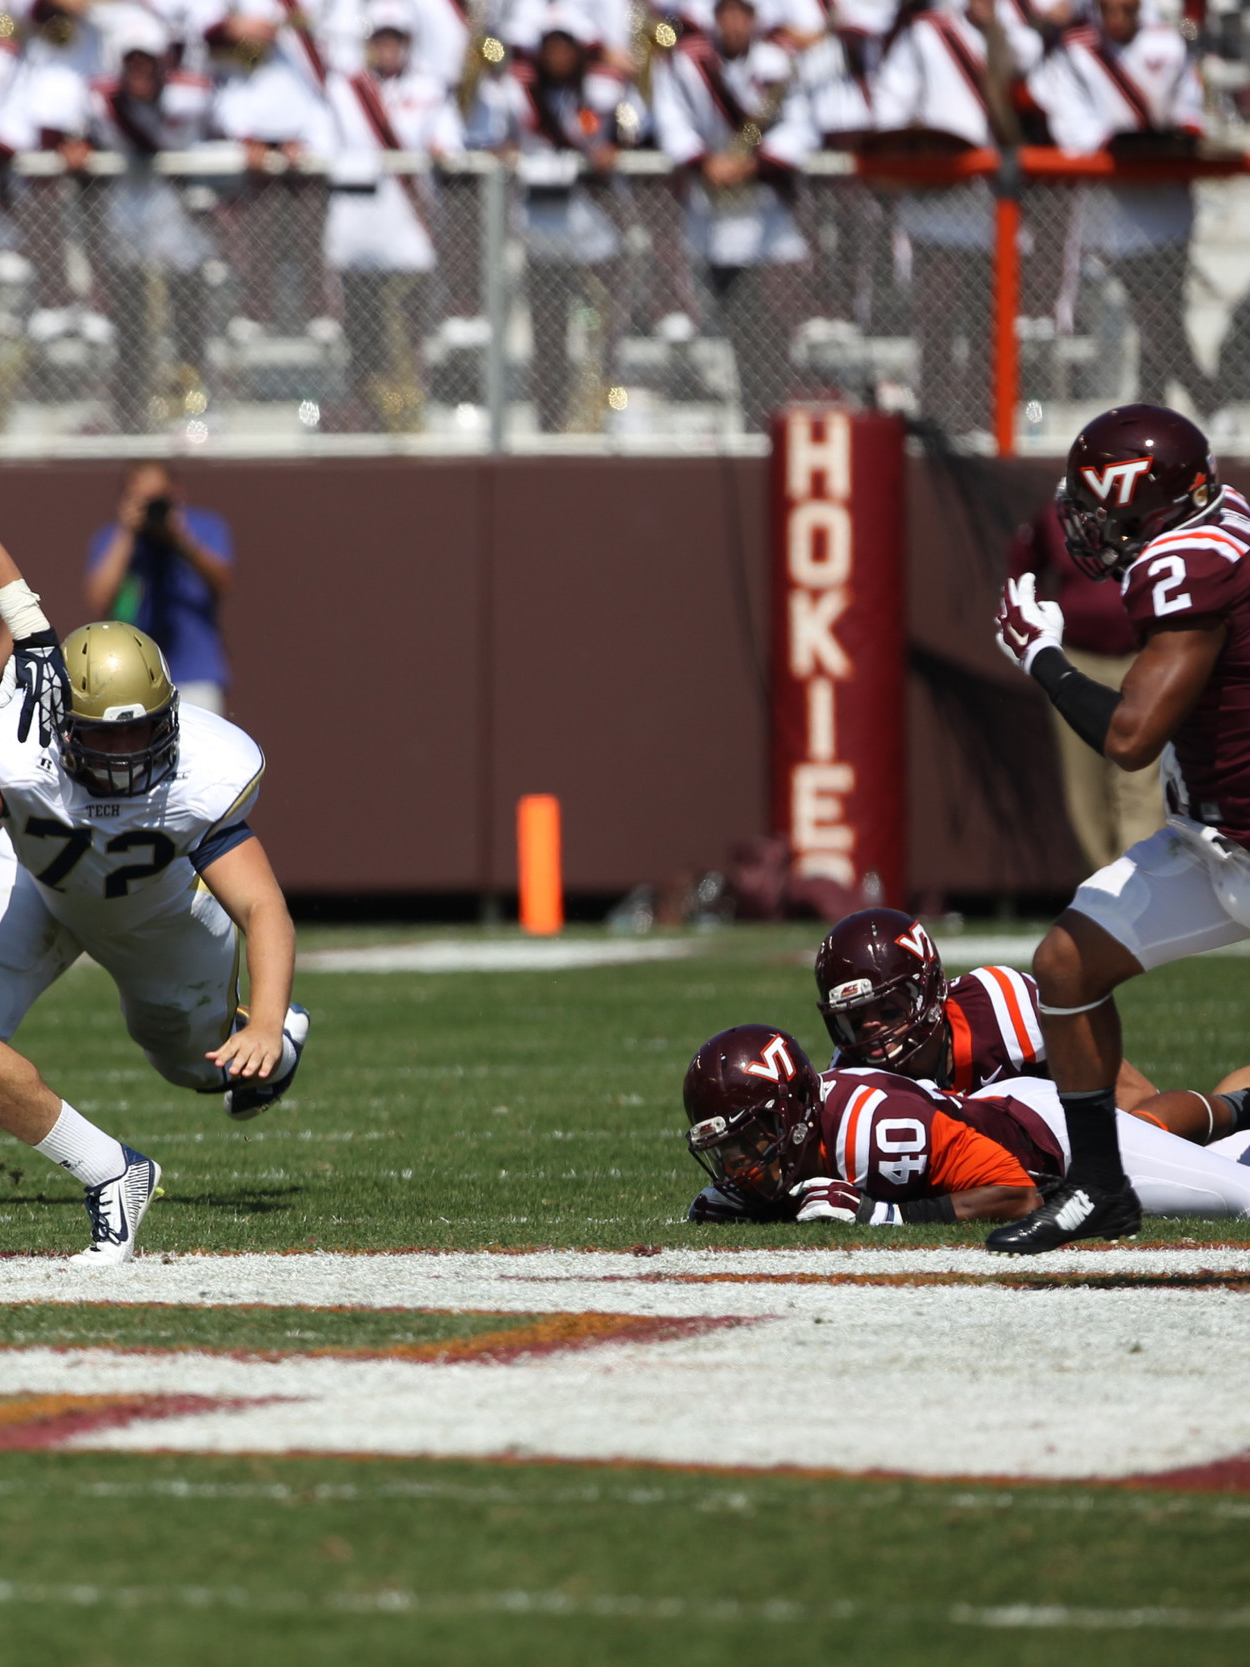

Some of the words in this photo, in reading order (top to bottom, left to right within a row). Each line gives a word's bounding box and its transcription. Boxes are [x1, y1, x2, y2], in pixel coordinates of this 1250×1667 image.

[1080, 456, 1153, 508] VT
[1148, 555, 1192, 617] 2
[86, 805, 120, 817] TECH
[24, 815, 177, 899] 72
[743, 1033, 797, 1083] VT
[875, 1118, 928, 1185] 40
[1054, 1189, 1096, 1231] NIKE
